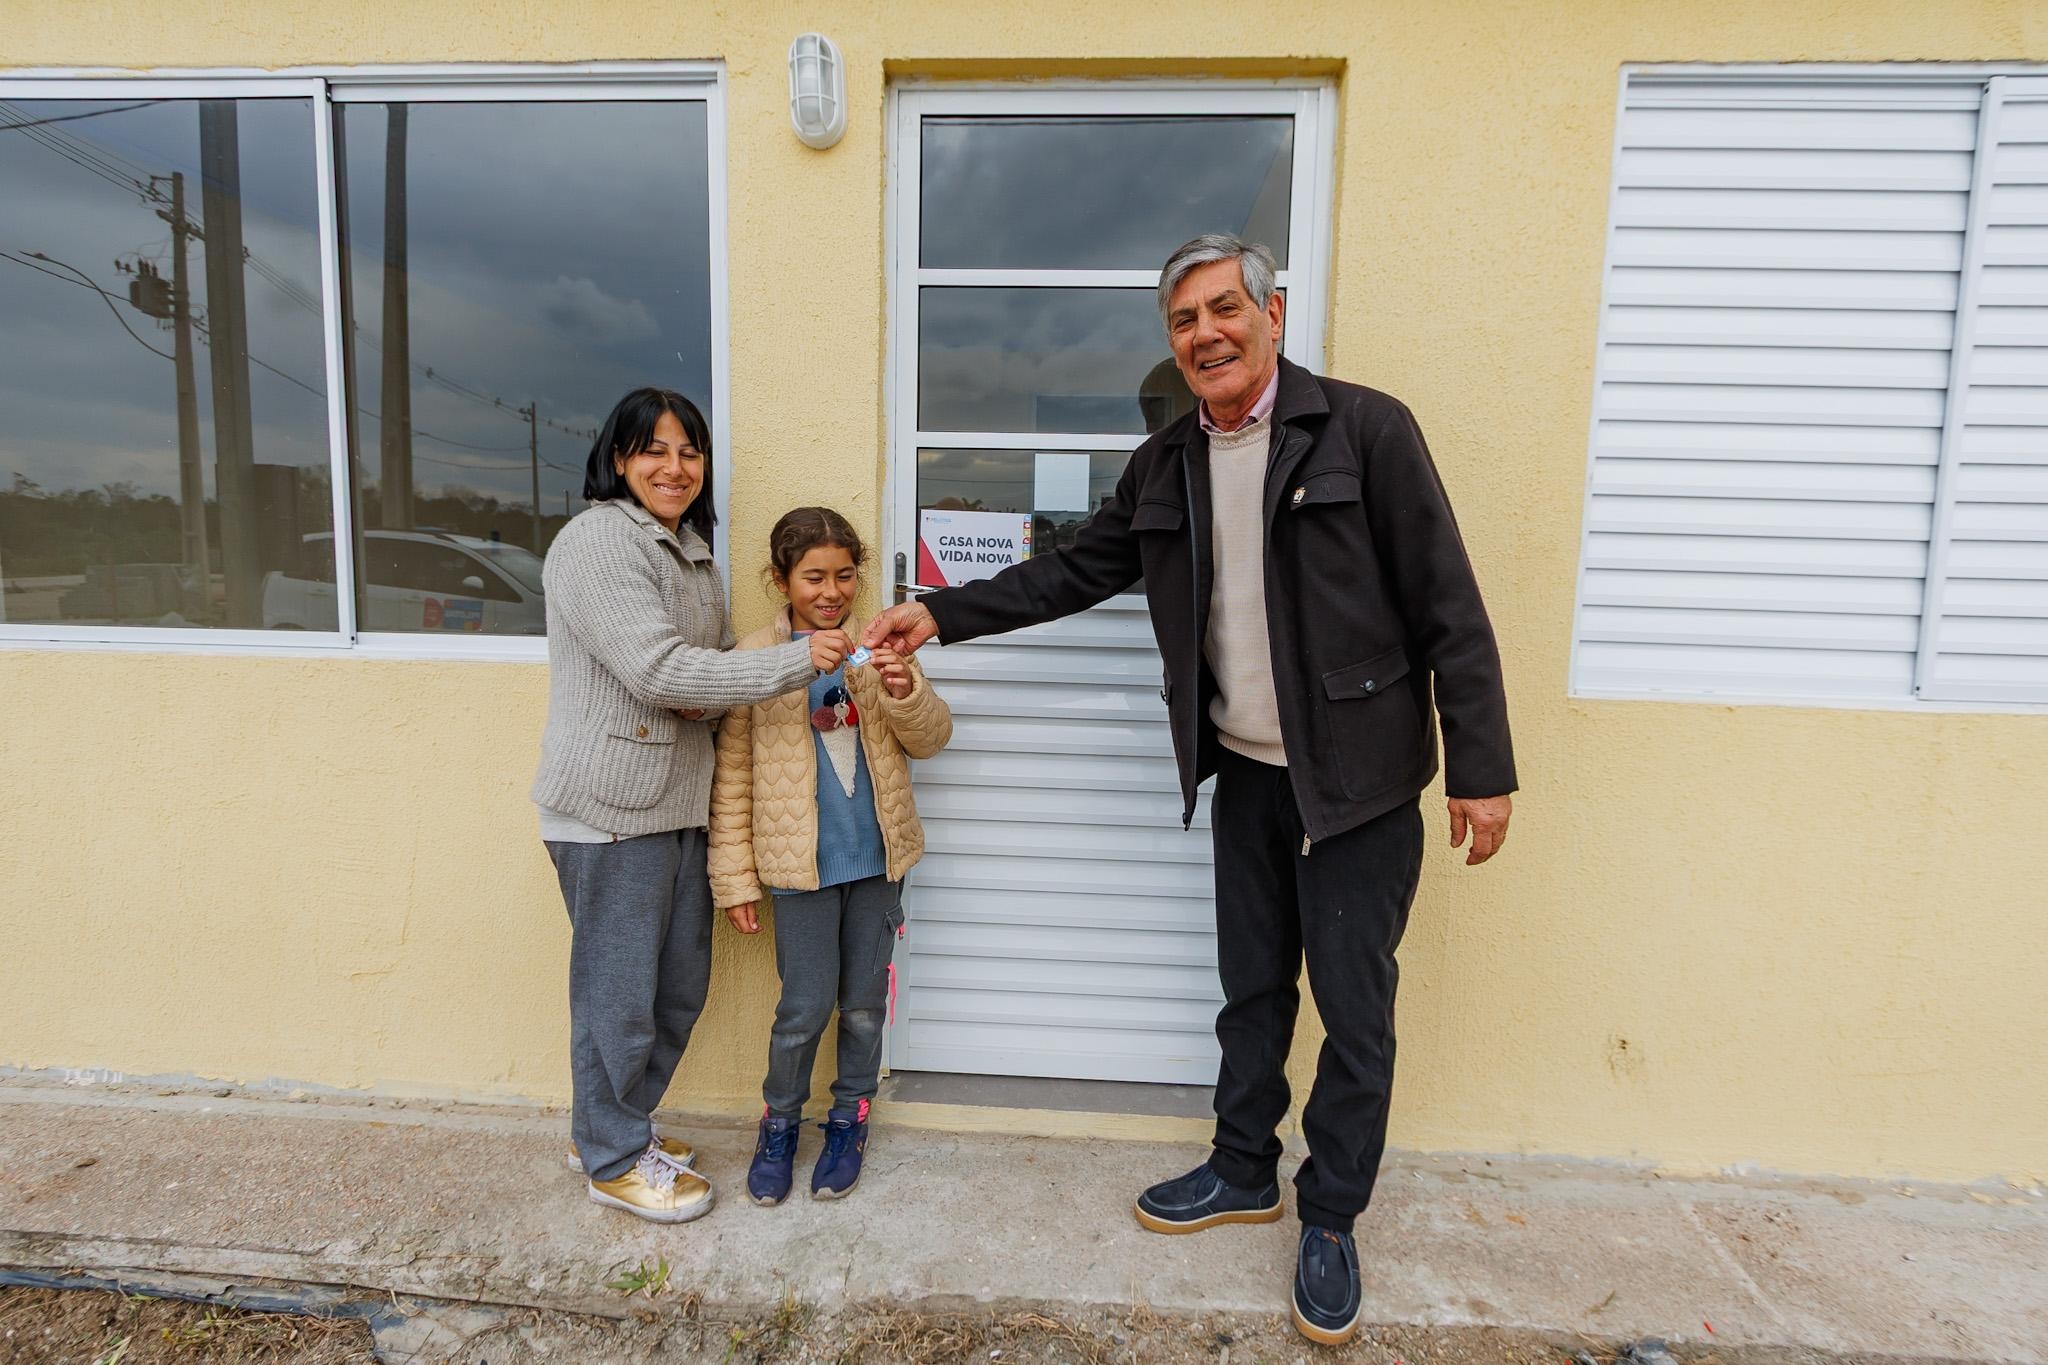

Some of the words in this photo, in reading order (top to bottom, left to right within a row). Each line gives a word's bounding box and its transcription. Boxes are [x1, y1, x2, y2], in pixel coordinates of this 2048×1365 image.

[939, 536, 973, 547] CASA
[976, 537, 1013, 549] NOVA
[939, 550, 973, 562] VIDA
[976, 553, 1013, 564] NOVA
